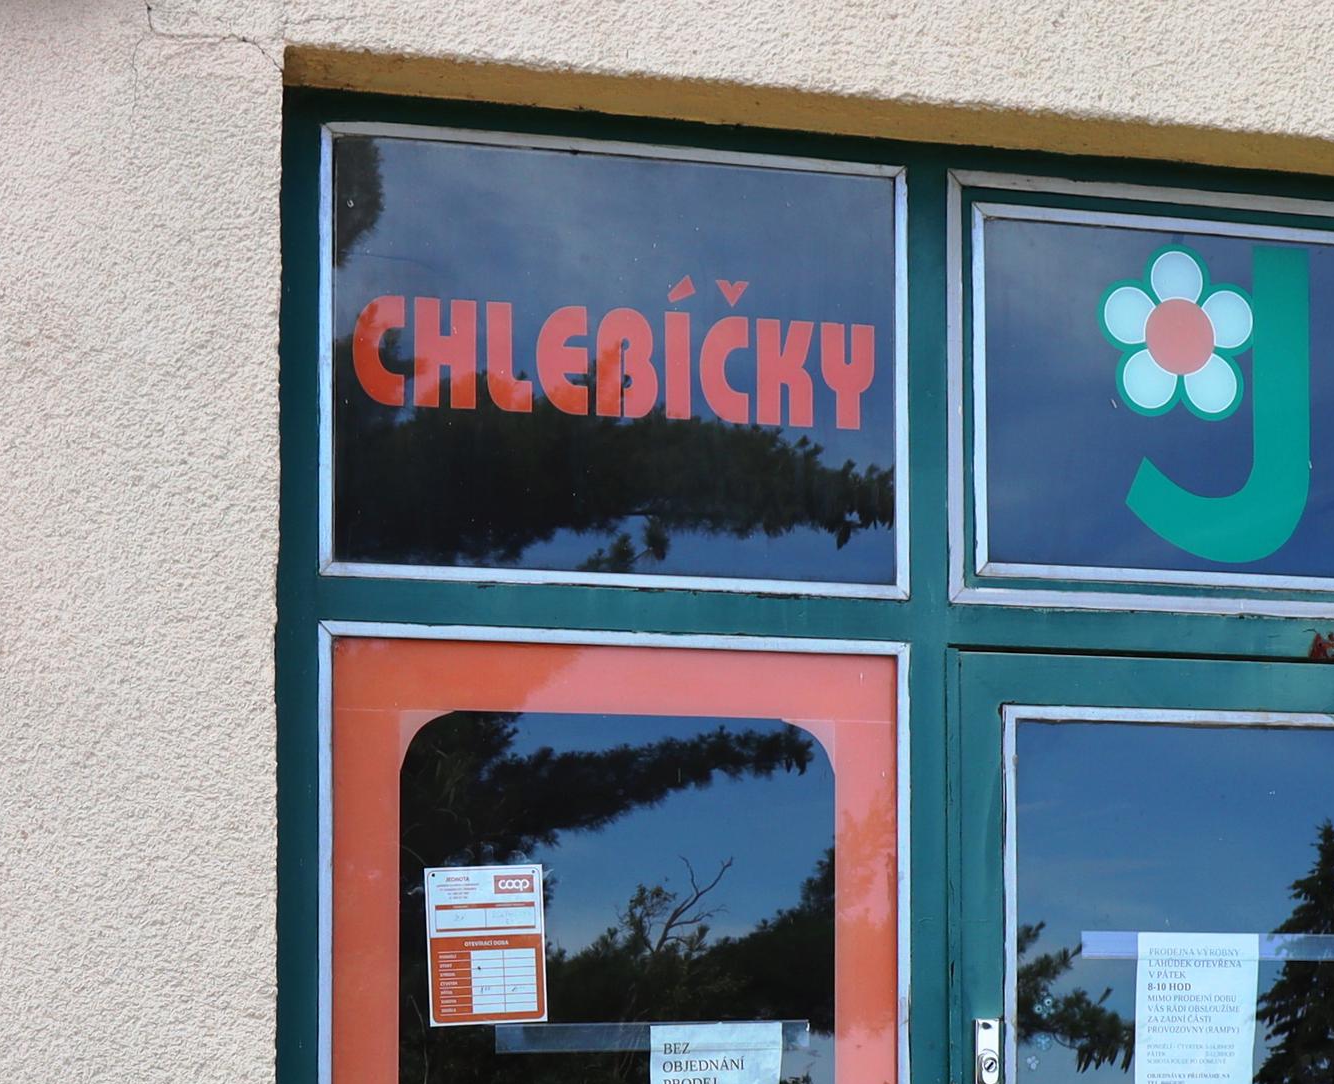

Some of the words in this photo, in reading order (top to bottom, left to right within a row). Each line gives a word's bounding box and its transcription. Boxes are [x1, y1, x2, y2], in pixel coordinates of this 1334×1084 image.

[353, 274, 875, 430] CHLEBÍČKY
[498, 879, 530, 892] coop
[1148, 971, 1156, 979] V
[1156, 969, 1186, 979] PÁTEK
[1147, 983, 1166, 991] 8-10
[1168, 982, 1192, 991] HOD
[1147, 994, 1172, 1002] MIMO
[1147, 1004, 1164, 1013] VÁS
[1160, 1015, 1186, 1023] ZADNÍ
[1187, 1014, 1212, 1023] ČÁSTI
[1147, 1026, 1204, 1034] PROVOZOVNY
[663, 1043, 690, 1055] BEZ
[662, 1056, 745, 1072] OBJEDNÁNÍ
